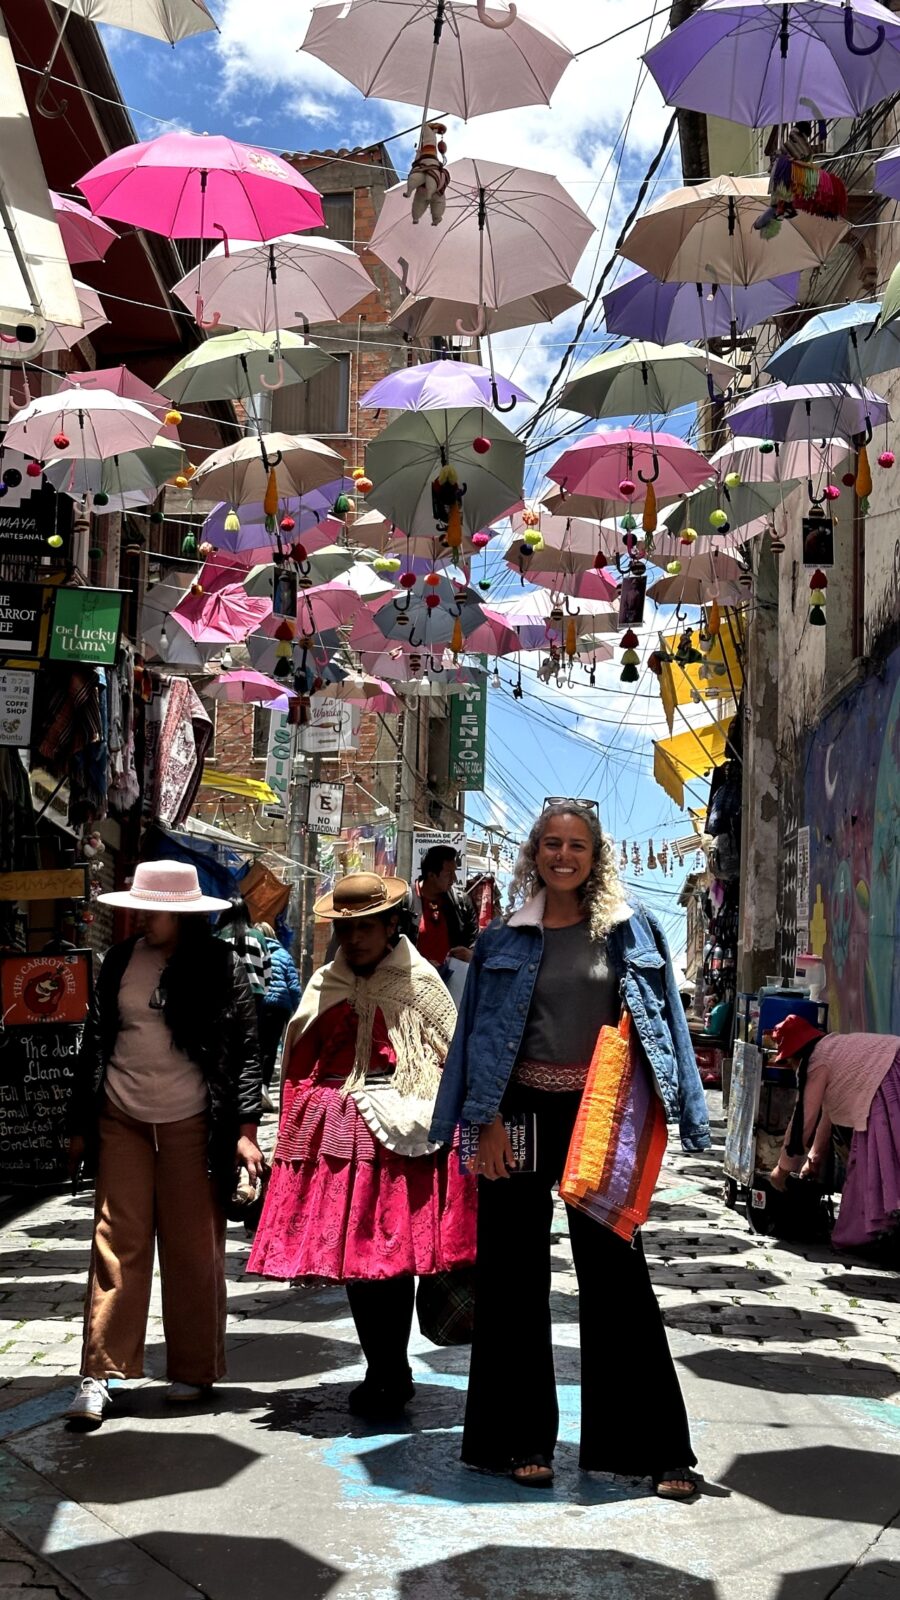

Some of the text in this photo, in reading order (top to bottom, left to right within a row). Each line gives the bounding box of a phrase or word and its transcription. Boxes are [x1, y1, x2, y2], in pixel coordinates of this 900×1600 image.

[74, 624, 116, 645] Lucky
[6, 707, 27, 715] SHOP
[320, 795, 333, 811] E
[317, 816, 330, 825] NO
[13, 974, 25, 998] THE
[20, 957, 65, 975] CARROT
[61, 966, 76, 994] TREE
[20, 1034, 48, 1059] The
[24, 1060, 75, 1083] Llama
[461, 1126, 471, 1165] ISABEL
